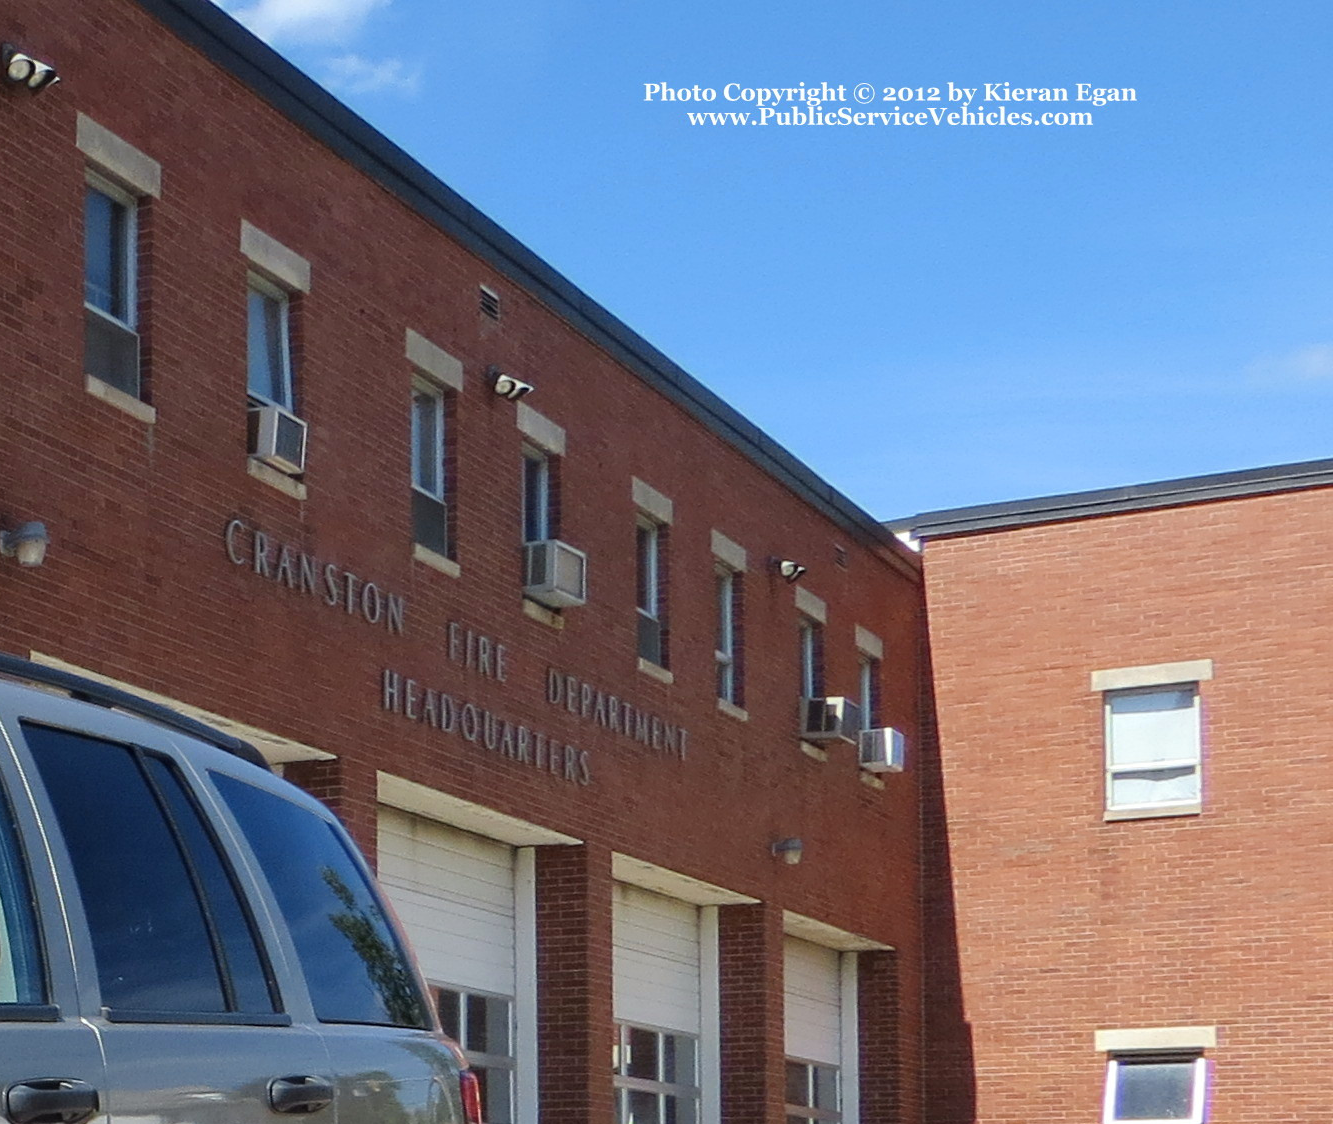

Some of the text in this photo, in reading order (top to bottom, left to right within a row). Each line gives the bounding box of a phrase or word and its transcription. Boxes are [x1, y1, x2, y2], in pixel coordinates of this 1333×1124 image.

[225, 520, 689, 762] CRANSTON FIRE DEPARTMENT
[382, 669, 590, 786] HEADQUARTERS
